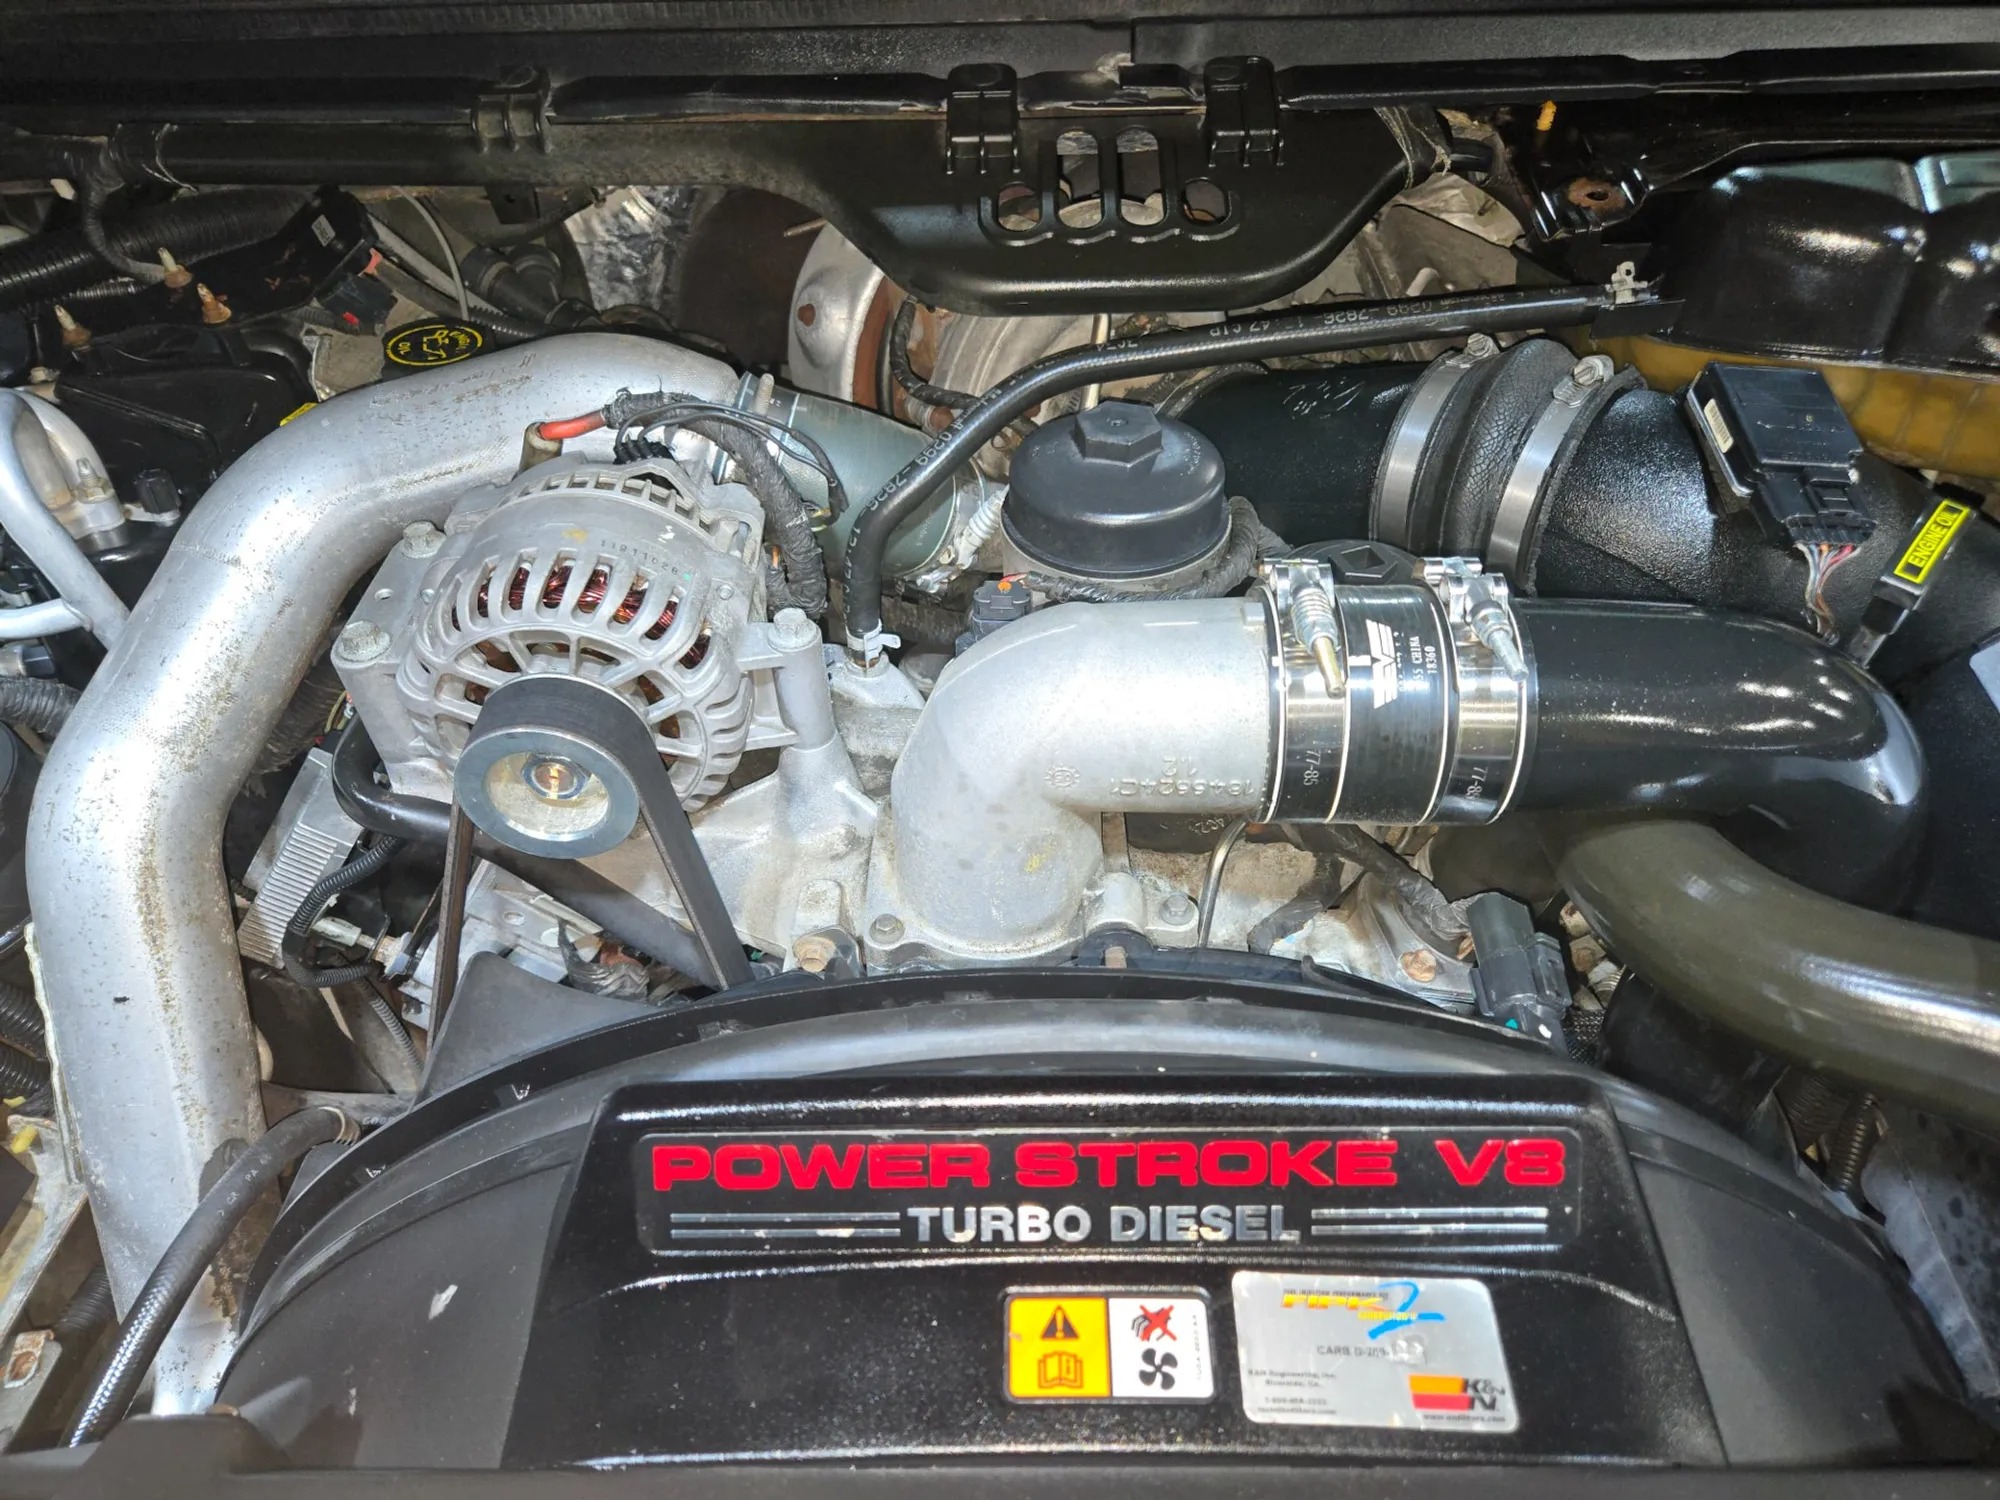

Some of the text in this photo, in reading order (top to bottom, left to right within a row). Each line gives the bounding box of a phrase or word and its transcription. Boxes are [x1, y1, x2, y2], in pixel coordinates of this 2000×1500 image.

[1907, 510, 1959, 569] ENGINE OIL
[1424, 645, 1438, 674] 18360
[1304, 749, 1321, 785] 77-85
[652, 1139, 1566, 1191] POWER STROKE V8
[906, 1204, 1300, 1243] TURBO DIESEL
[1317, 1345, 1349, 1357] CARB
